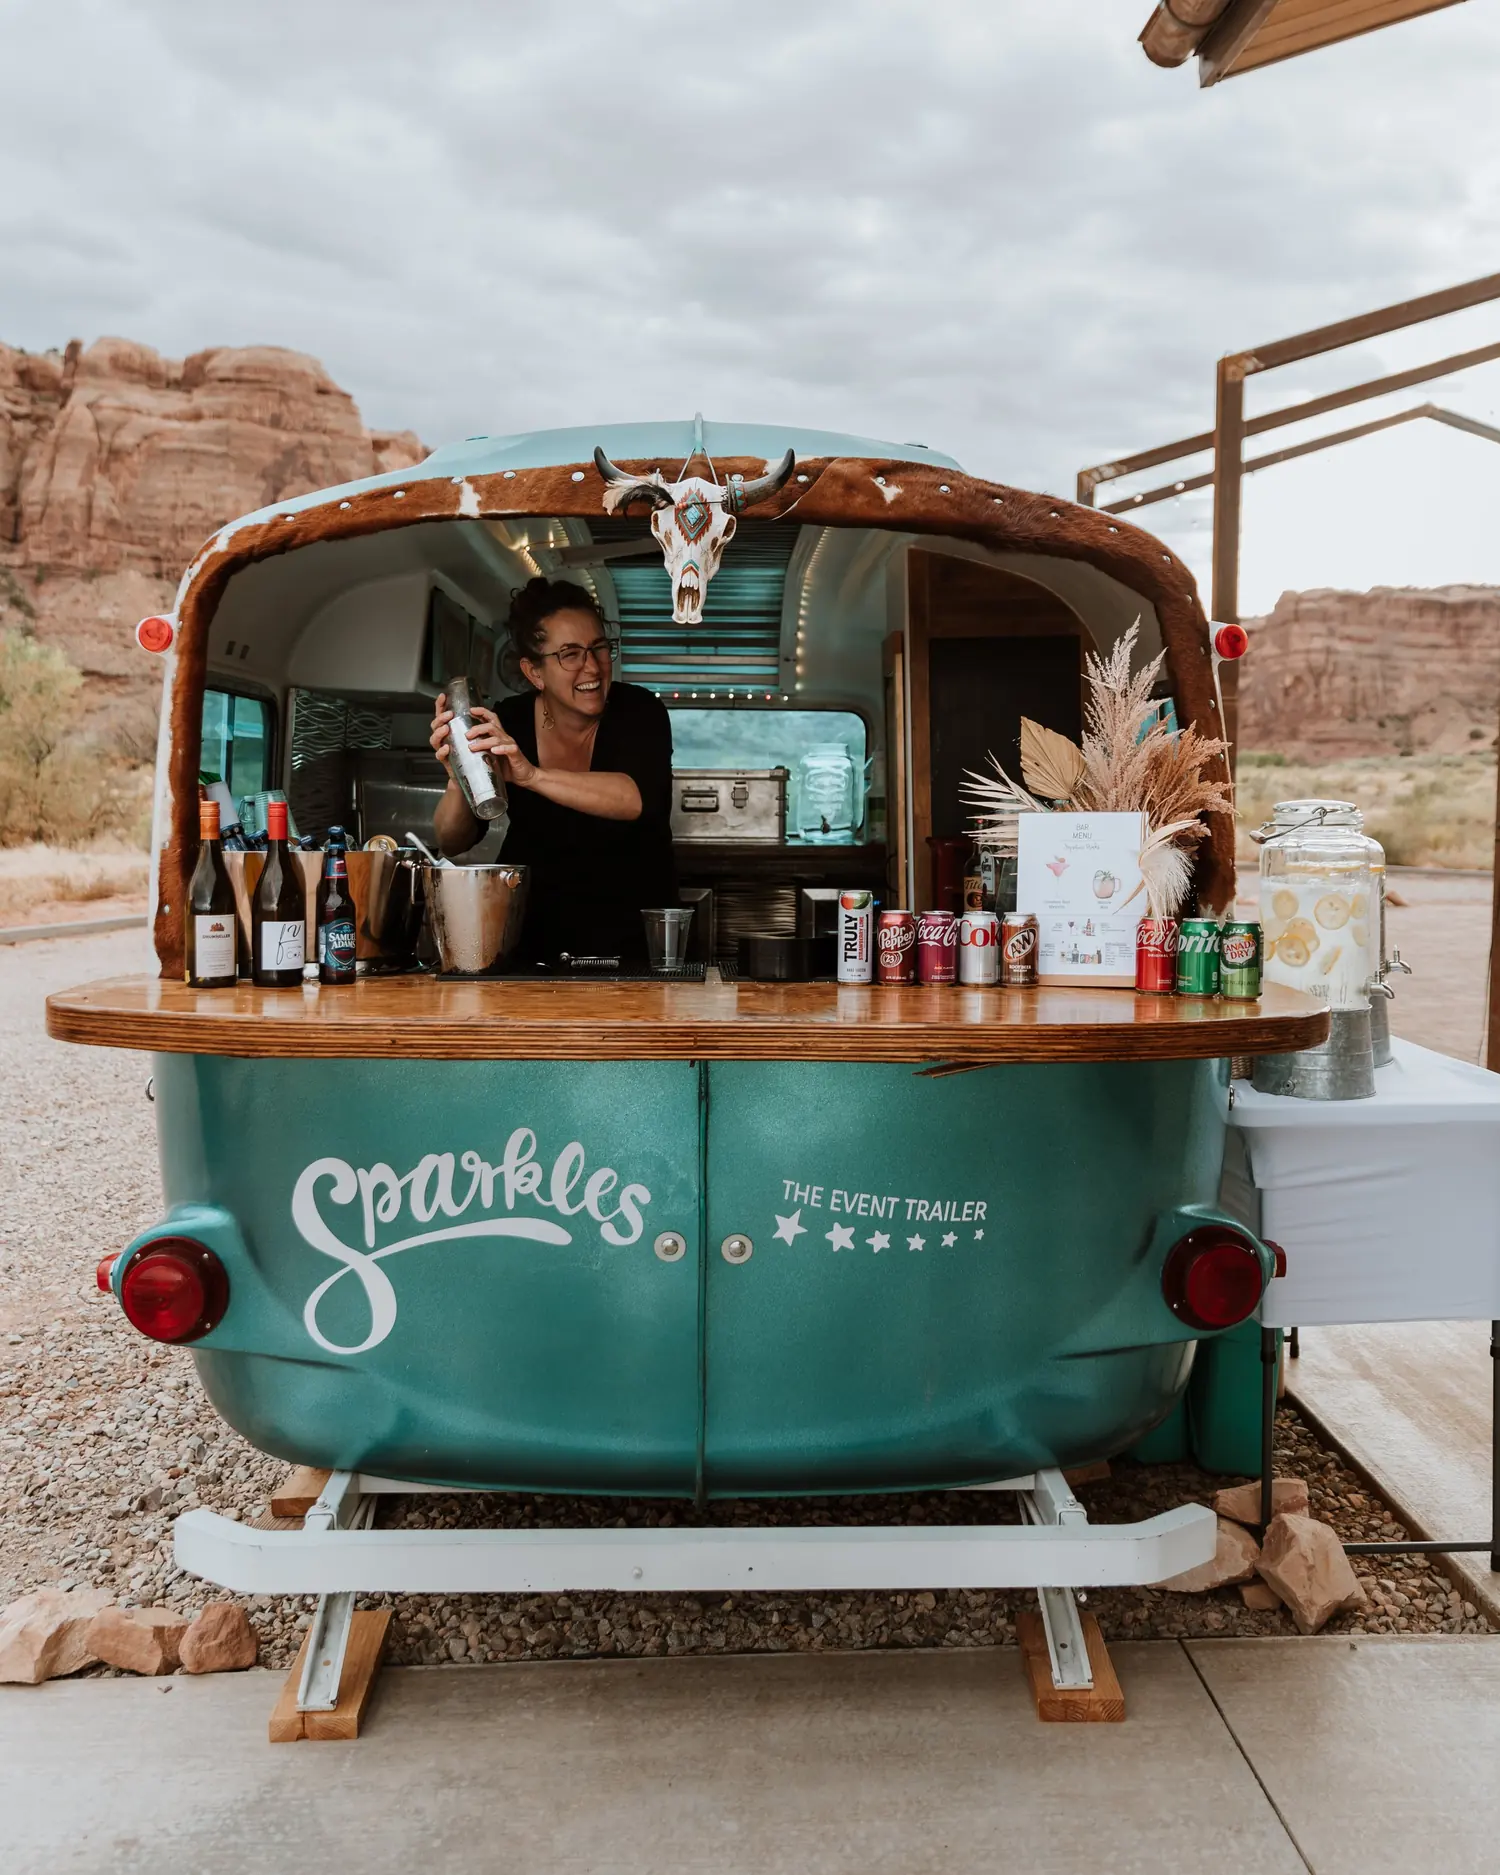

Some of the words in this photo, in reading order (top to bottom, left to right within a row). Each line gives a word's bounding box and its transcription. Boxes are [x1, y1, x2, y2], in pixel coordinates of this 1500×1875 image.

[1076, 823, 1089, 831] BAR
[328, 932, 356, 942] SAMUEL
[890, 925, 906, 937] Dr
[960, 919, 997, 947] Cok
[844, 914, 858, 962] TRULY
[880, 928, 914, 950] Pepper
[331, 940, 355, 950] ADAMS
[1223, 940, 1256, 955] CANADA
[885, 954, 895, 963] 23
[1230, 949, 1249, 959] DRY
[782, 1179, 824, 1208] THE
[830, 1189, 900, 1220] EVENT
[904, 1198, 988, 1222] TRAILER
[291, 1127, 651, 1355] Sparkles
